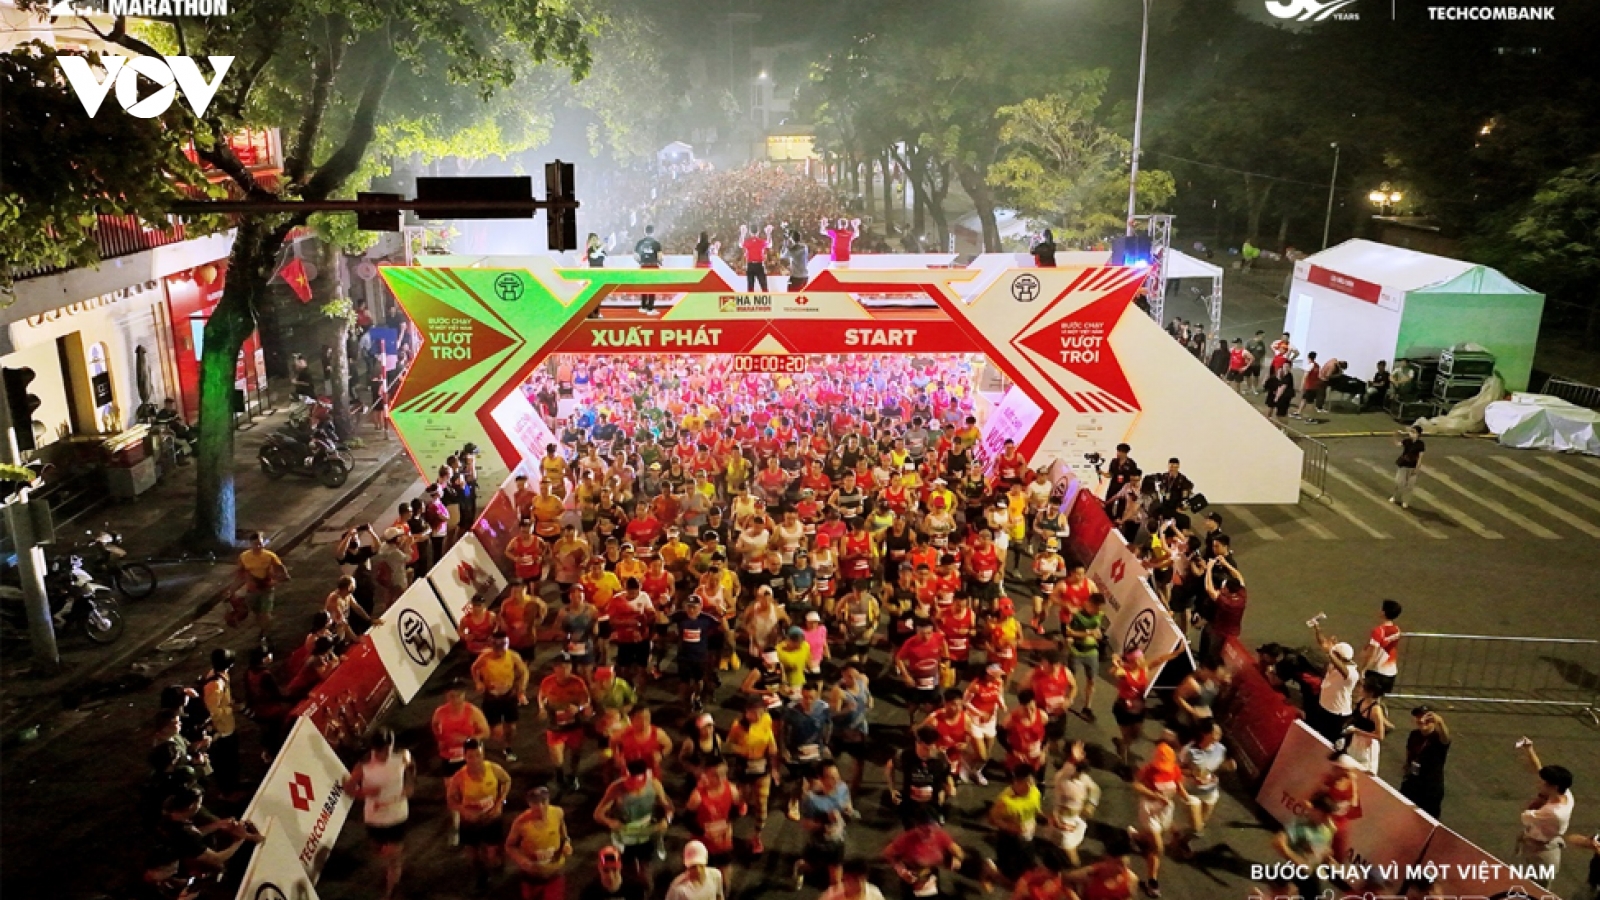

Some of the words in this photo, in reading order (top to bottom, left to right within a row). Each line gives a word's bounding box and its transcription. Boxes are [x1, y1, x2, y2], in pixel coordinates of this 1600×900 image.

[428, 331, 473, 346] VƯỢT
[591, 324, 654, 347] XUẤT
[660, 324, 723, 346] PHÁT
[844, 328, 917, 346] START
[1060, 335, 1103, 350] VƯỢT
[735, 355, 804, 372] 00:00:20
[299, 780, 343, 866] TECHCOMBANK
